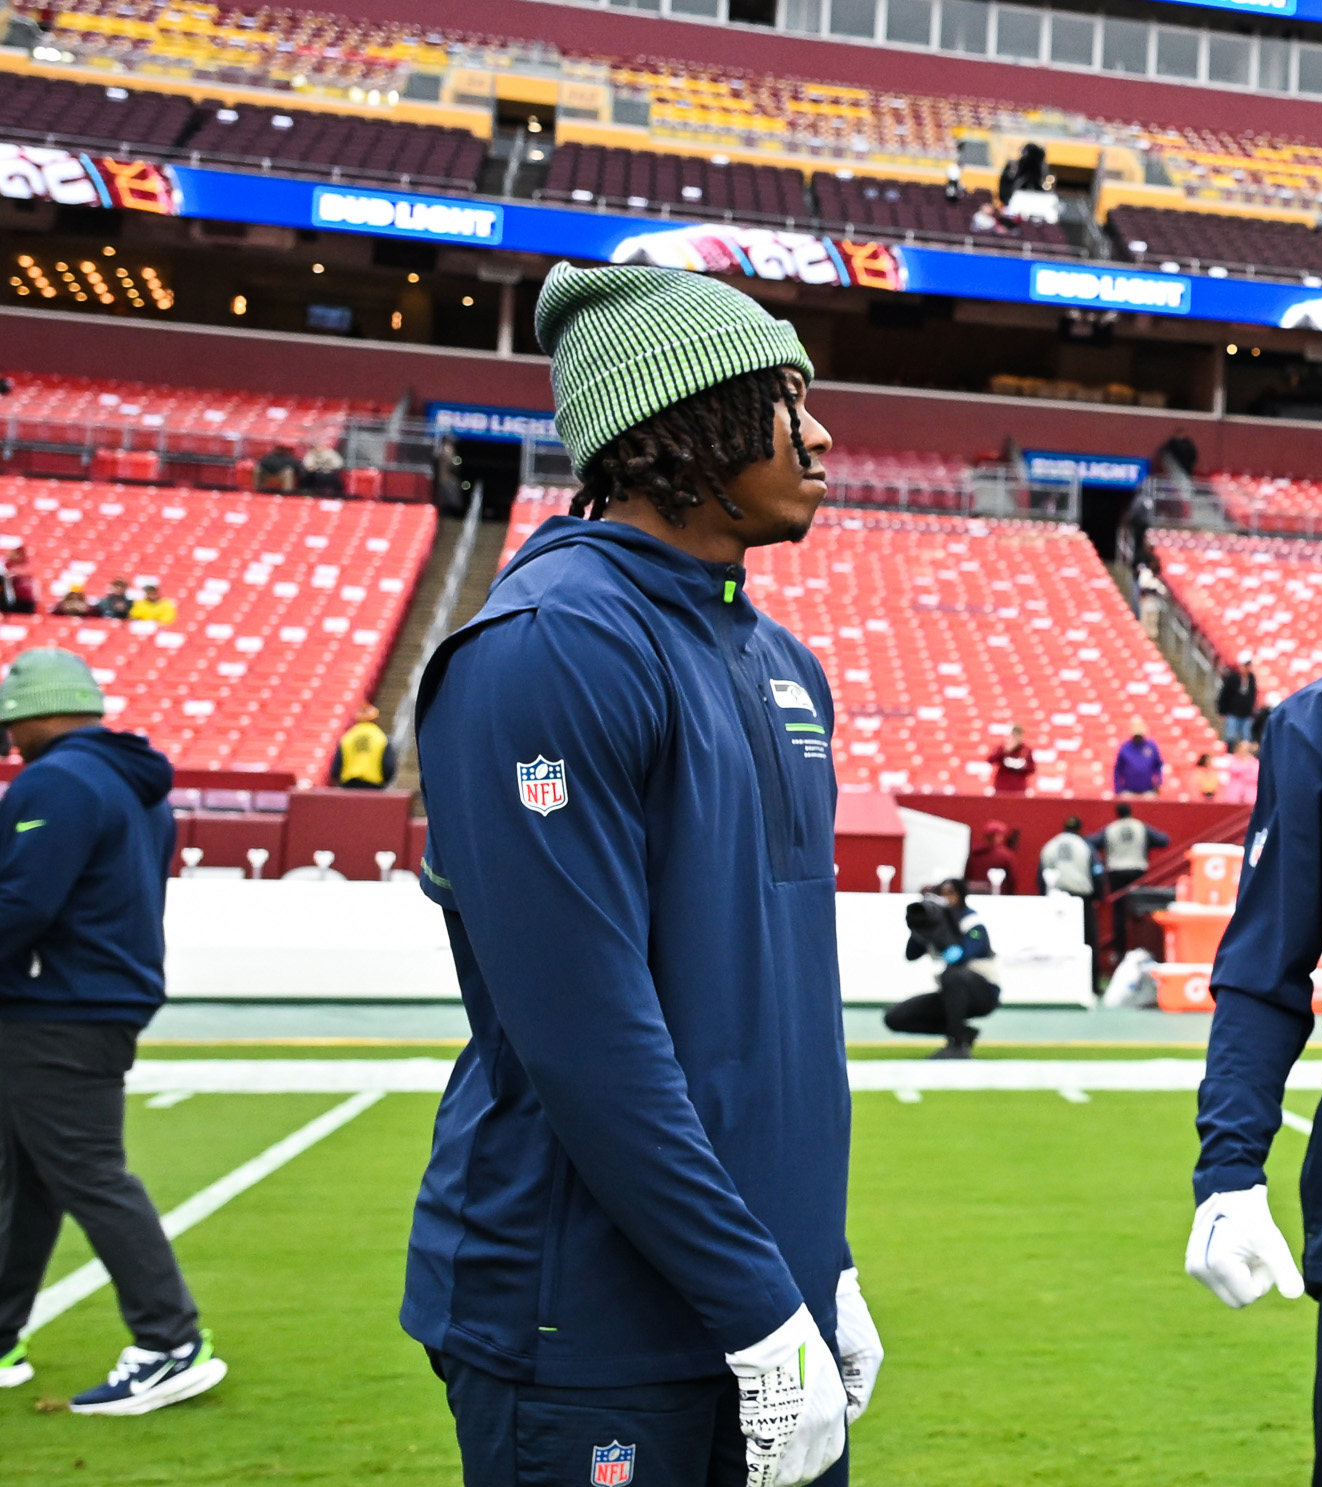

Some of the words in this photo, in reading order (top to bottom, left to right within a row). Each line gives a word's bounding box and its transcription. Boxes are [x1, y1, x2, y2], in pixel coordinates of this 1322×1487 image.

[319, 192, 395, 227] BUD
[394, 200, 497, 238] LIGHT
[526, 781, 563, 806] NFL
[596, 1463, 629, 1485] NFL
